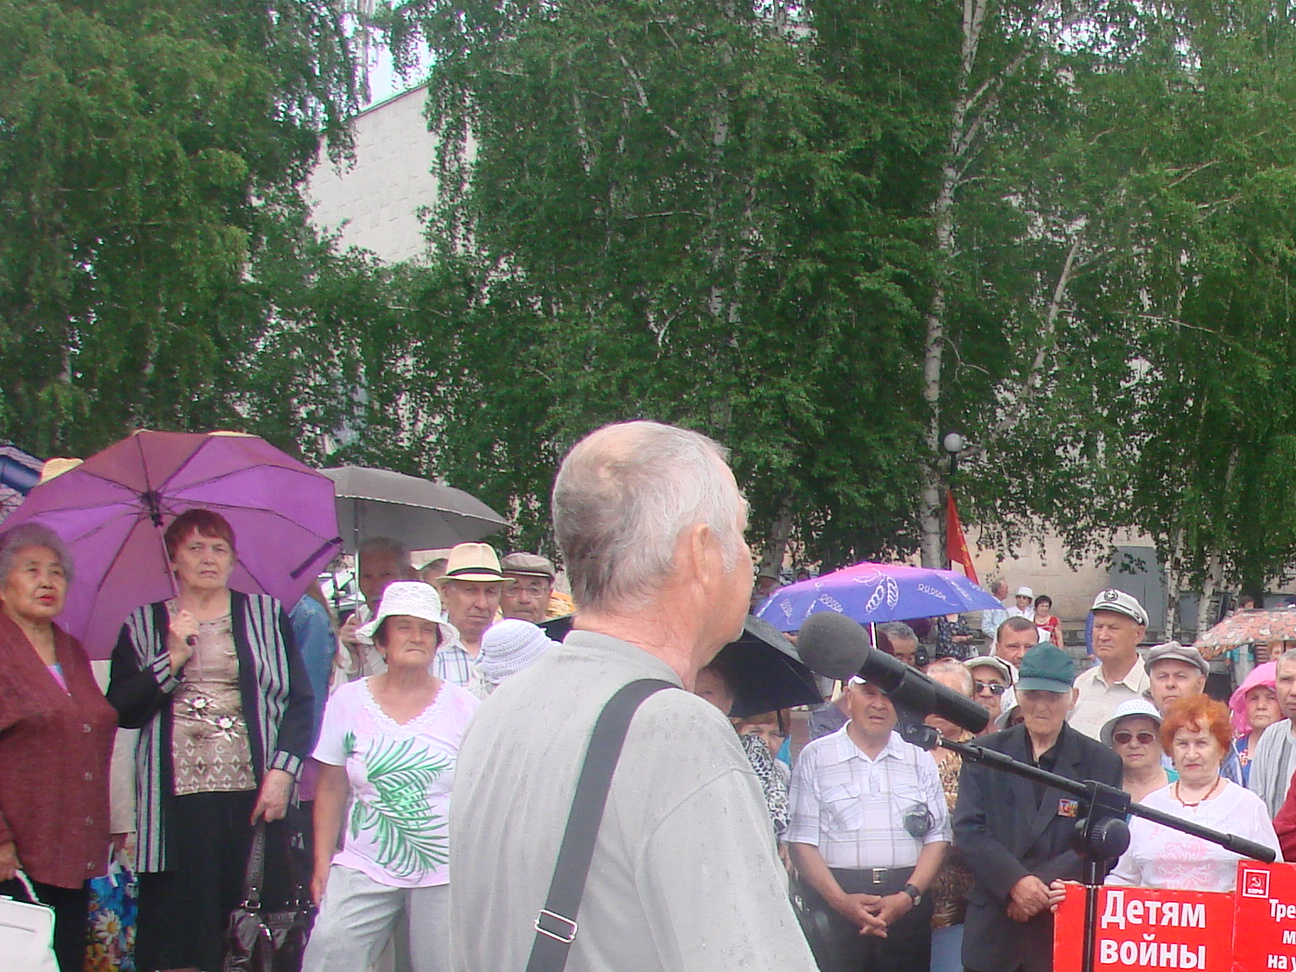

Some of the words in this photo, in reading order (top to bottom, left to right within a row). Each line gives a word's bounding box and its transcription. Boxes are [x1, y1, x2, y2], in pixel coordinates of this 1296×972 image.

[1101, 890, 1206, 930] Детям
[1100, 933, 1206, 970] войны
[1267, 954, 1288, 970] на
